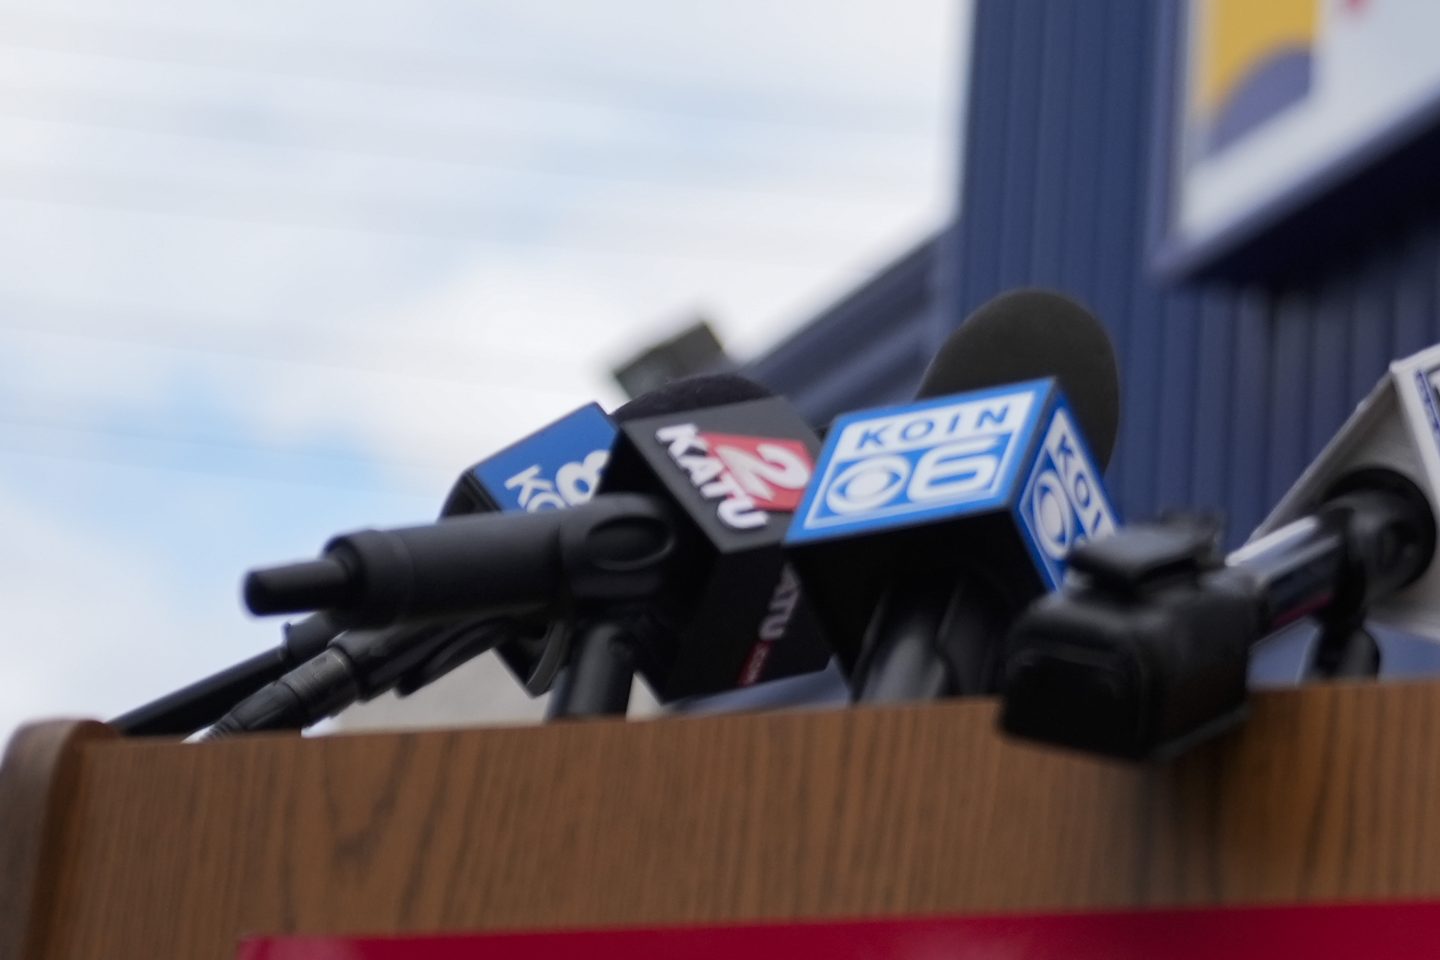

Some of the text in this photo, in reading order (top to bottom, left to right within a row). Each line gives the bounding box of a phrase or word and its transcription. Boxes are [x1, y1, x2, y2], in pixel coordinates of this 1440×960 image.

[857, 404, 1010, 451] KOIN
[655, 423, 769, 529] KATU
[714, 443, 810, 502] 2
[1057, 433, 1102, 535] KOI
